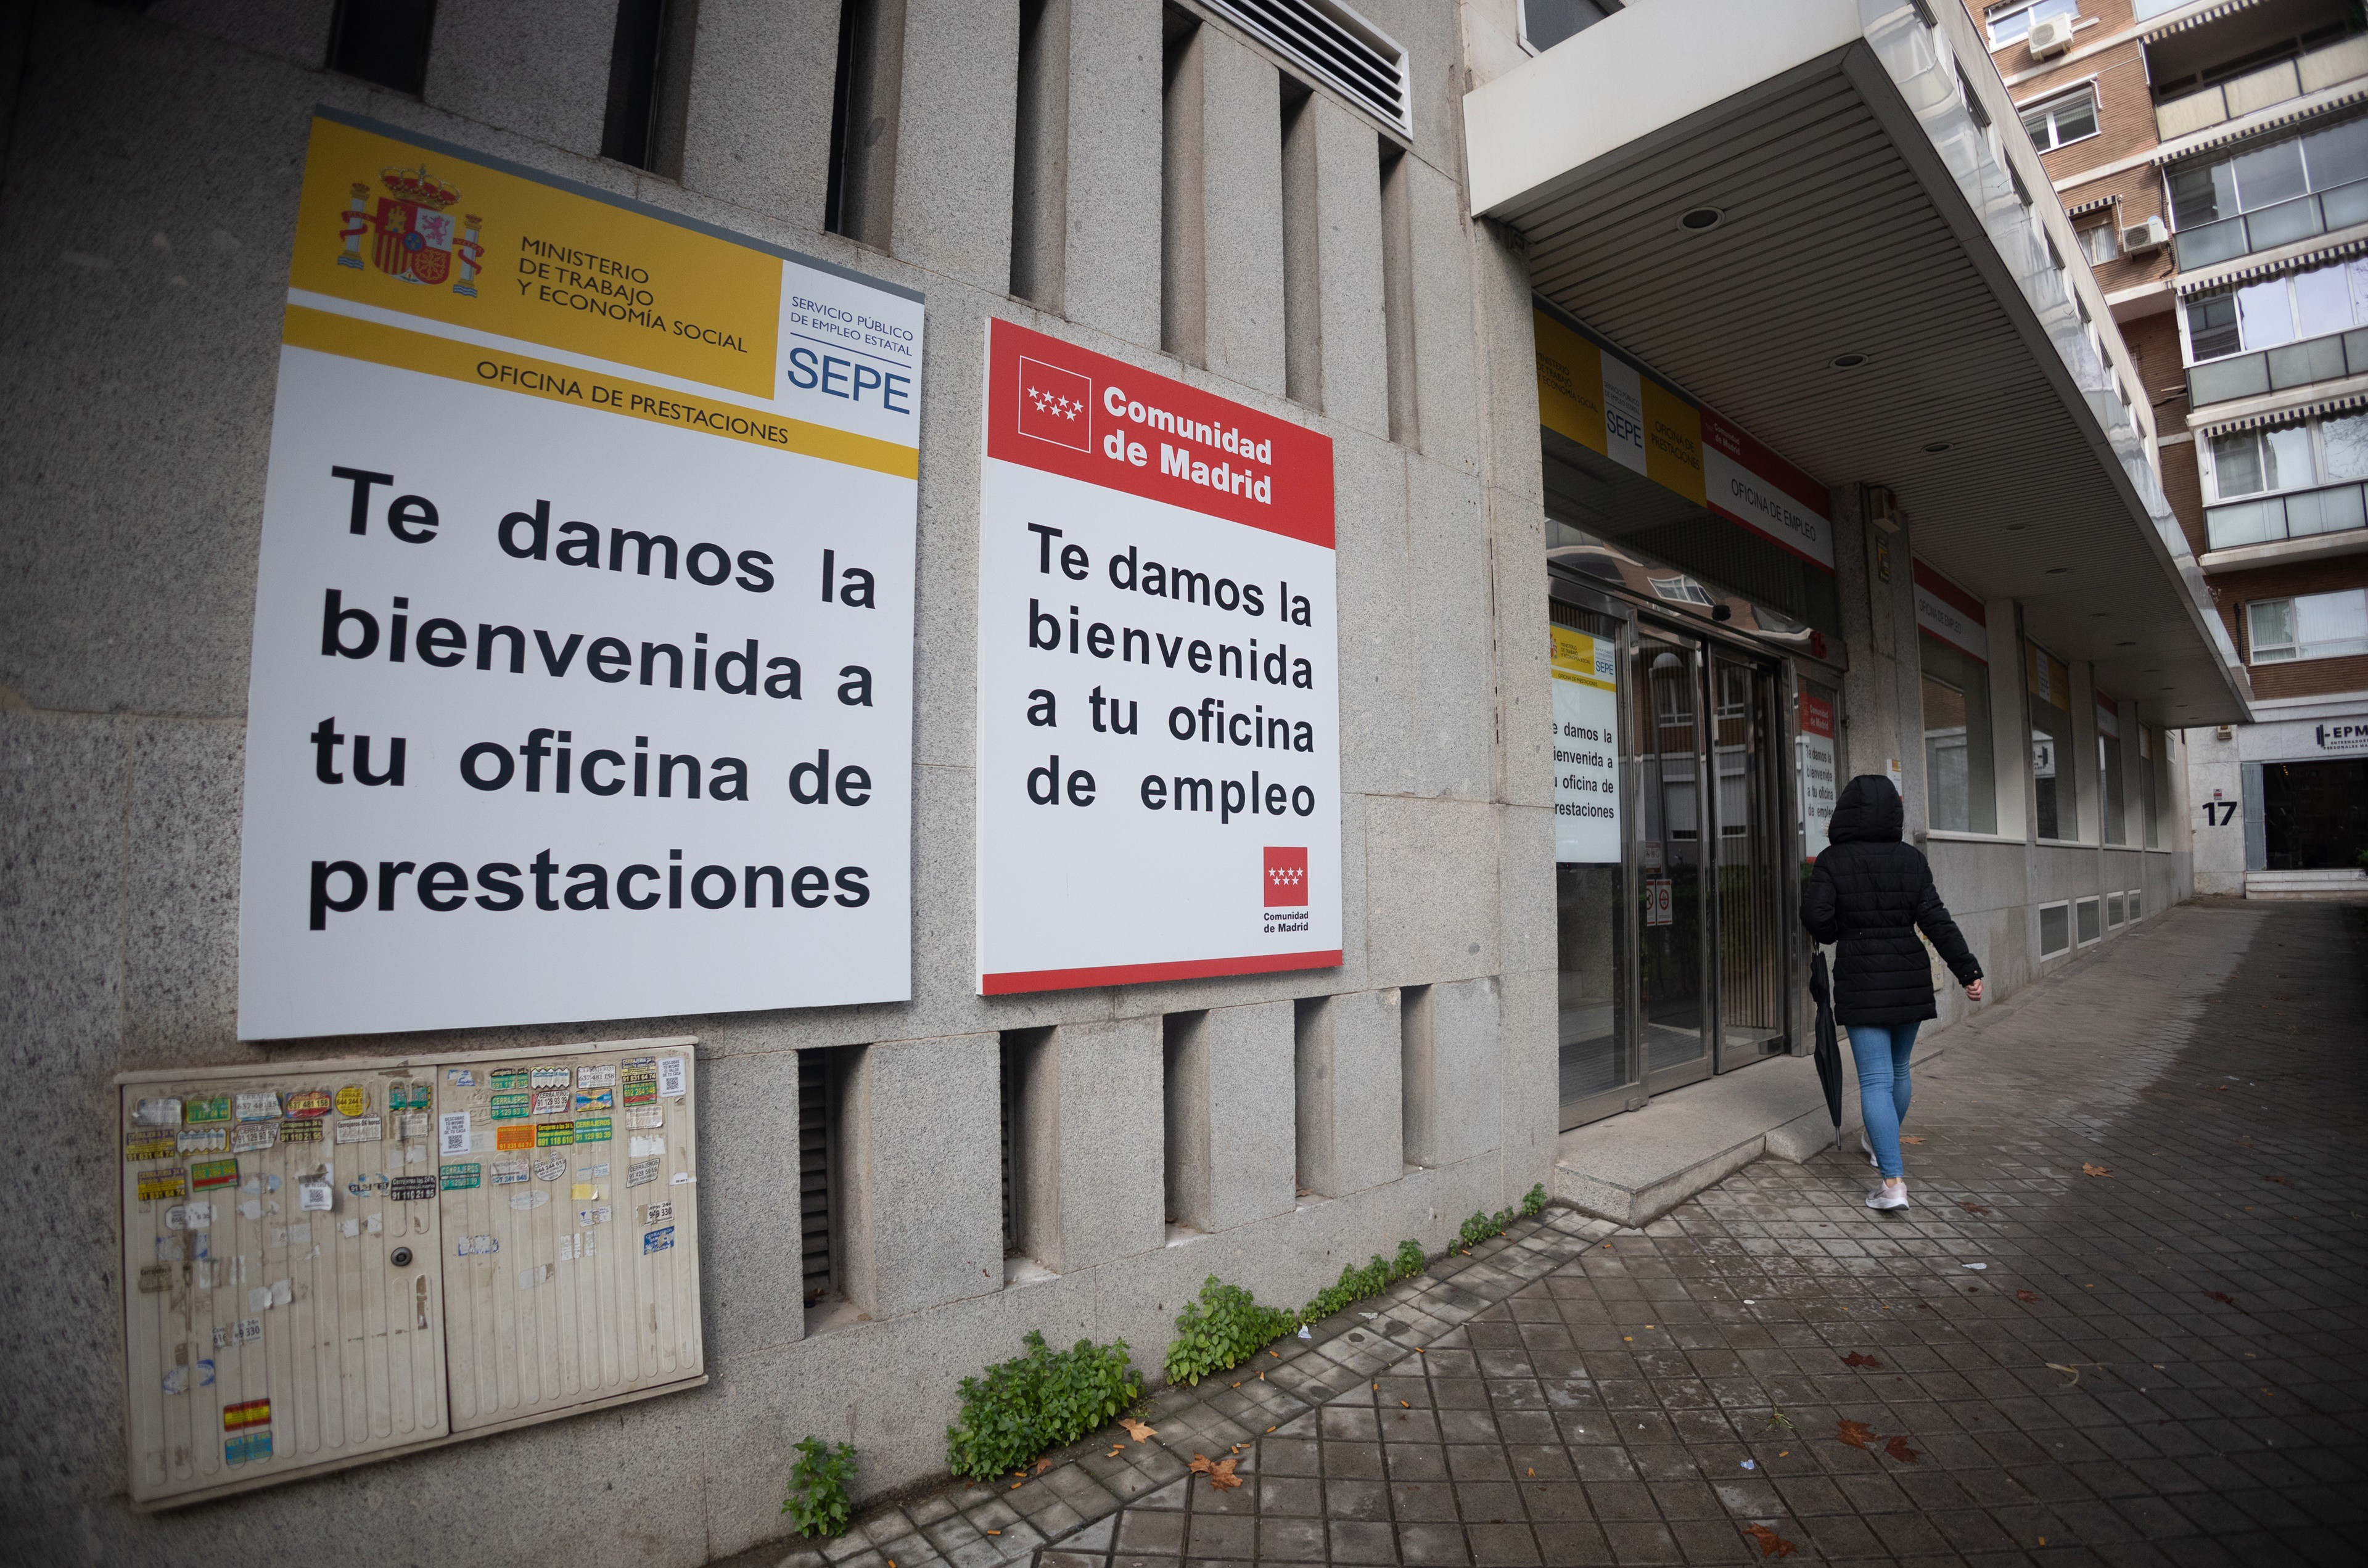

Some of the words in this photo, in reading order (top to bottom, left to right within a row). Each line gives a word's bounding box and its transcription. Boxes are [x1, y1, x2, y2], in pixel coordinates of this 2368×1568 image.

[521, 236, 649, 284] MINISTERIO
[519, 258, 550, 279] DE
[555, 267, 654, 306] TRABAJO
[517, 279, 532, 295] Y
[539, 285, 667, 332] ECONOMÍA
[673, 321, 747, 353] SOCIAL
[792, 297, 853, 322] SERVICIO
[857, 316, 913, 341] PÚBLICO
[791, 312, 808, 326] DE
[812, 319, 861, 340] EMPLEO
[865, 334, 912, 356] ESTATAL
[1536, 350, 1570, 377] MINISTERIO
[1536, 361, 1545, 373] DE
[1546, 368, 1572, 387] TRABAJO
[788, 347, 910, 415] SEPE
[1604, 381, 1622, 396] SERVICIO
[477, 361, 583, 399] OFICINA
[591, 385, 623, 408] DE
[630, 394, 788, 444] PRESTACIONES
[1577, 394, 1598, 413] SOCIAL
[1103, 386, 1272, 466] Comunidad
[1606, 409, 1643, 449] SEPE
[1655, 421, 1684, 446] OFICINA
[1685, 438, 1695, 454] DE
[1714, 422, 1740, 446] Comunidad
[1651, 433, 1700, 471] PRESTACIONES
[1715, 433, 1722, 445] de
[1723, 437, 1741, 456] Madrid
[1103, 429, 1148, 466] de
[1161, 442, 1271, 504] Madrid
[1731, 478, 1769, 515] OFICINA
[1770, 501, 1782, 523] DE
[1784, 510, 1816, 542] EMPLEO
[331, 464, 439, 544] Te
[497, 498, 775, 593] damos
[821, 548, 876, 610] la
[1028, 522, 1089, 580] Te
[1109, 545, 1265, 617] damos
[1280, 581, 1312, 627] la
[321, 588, 803, 700] bienvenida
[837, 661, 874, 707] a
[1029, 598, 1313, 689] bienvenida
[1595, 660, 1614, 676] SEPE
[1027, 688, 1057, 728] a
[1088, 684, 1138, 736] tu
[1169, 697, 1314, 753] oficina
[1809, 704, 1829, 719] Comunidad
[1564, 721, 1598, 741] damos
[1604, 728, 1612, 744] la
[2333, 724, 2368, 738] EPM
[310, 716, 407, 787] tu
[459, 727, 749, 802] oficina
[788, 749, 873, 807] de
[1553, 745, 1603, 768] ienvenida
[1607, 757, 1613, 769] a
[1806, 744, 1812, 759] Te
[1812, 747, 1827, 763] damos
[1827, 750, 1832, 764] la
[1563, 774, 1598, 792] oficina
[1601, 779, 1614, 794] de
[1806, 764, 1833, 782] bienvenida
[1027, 754, 1096, 807] de
[1141, 770, 1315, 824] empleo
[1812, 785, 1817, 798] tu
[1819, 786, 1833, 800] oficina
[1554, 801, 1614, 819] restaciones
[1808, 803, 1814, 816] de
[2202, 801, 2238, 826] 17
[310, 848, 871, 931] prestaciones
[1264, 911, 1309, 921] Comunidad
[1264, 923, 1275, 934] de
[1278, 922, 1309, 933] Madrid
[576, 1119, 611, 1128] CERRAJEROS
[538, 1138, 548, 1146] 691
[629, 1159, 659, 1172] CERRAJEROS
[392, 1191, 400, 1199] 91
[402, 1191, 414, 1199] 110
[661, 1207, 672, 1215] 330
[246, 1325, 261, 1337] 330
